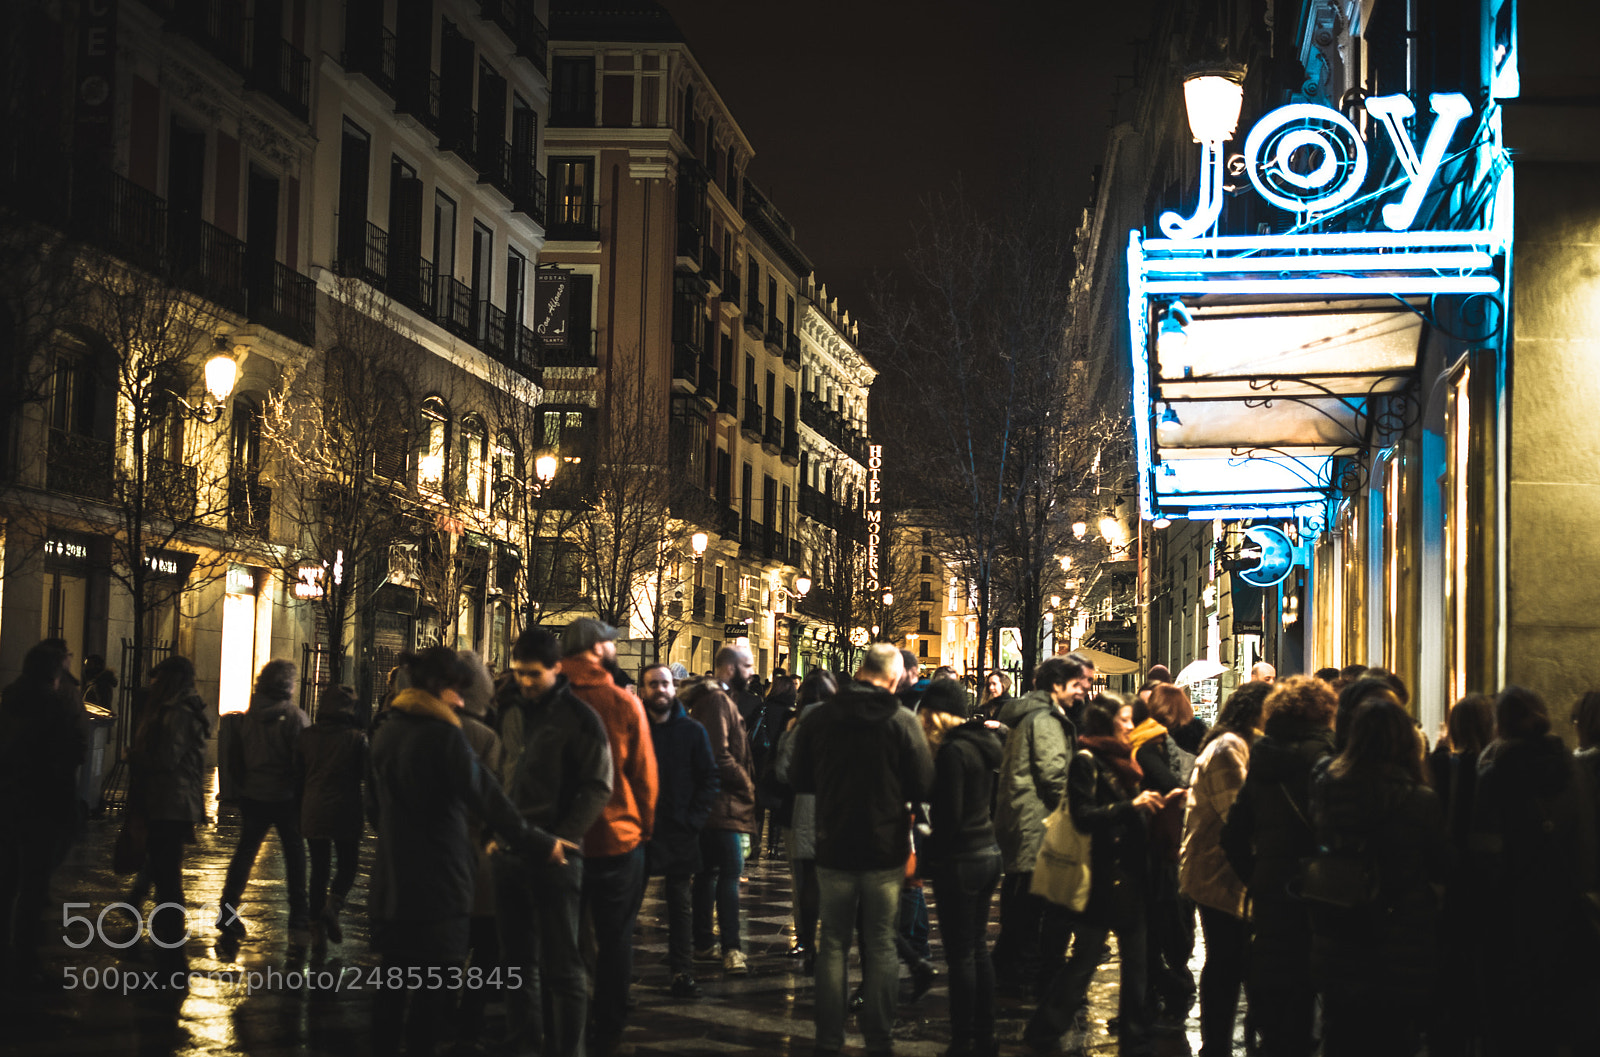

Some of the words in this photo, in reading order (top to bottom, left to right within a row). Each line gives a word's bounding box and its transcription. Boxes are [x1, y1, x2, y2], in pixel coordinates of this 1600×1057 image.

[1159, 91, 1473, 240] JOY
[868, 445, 883, 504] HOTEL
[866, 510, 882, 592] MODERNO
[726, 625, 748, 634] Etam
